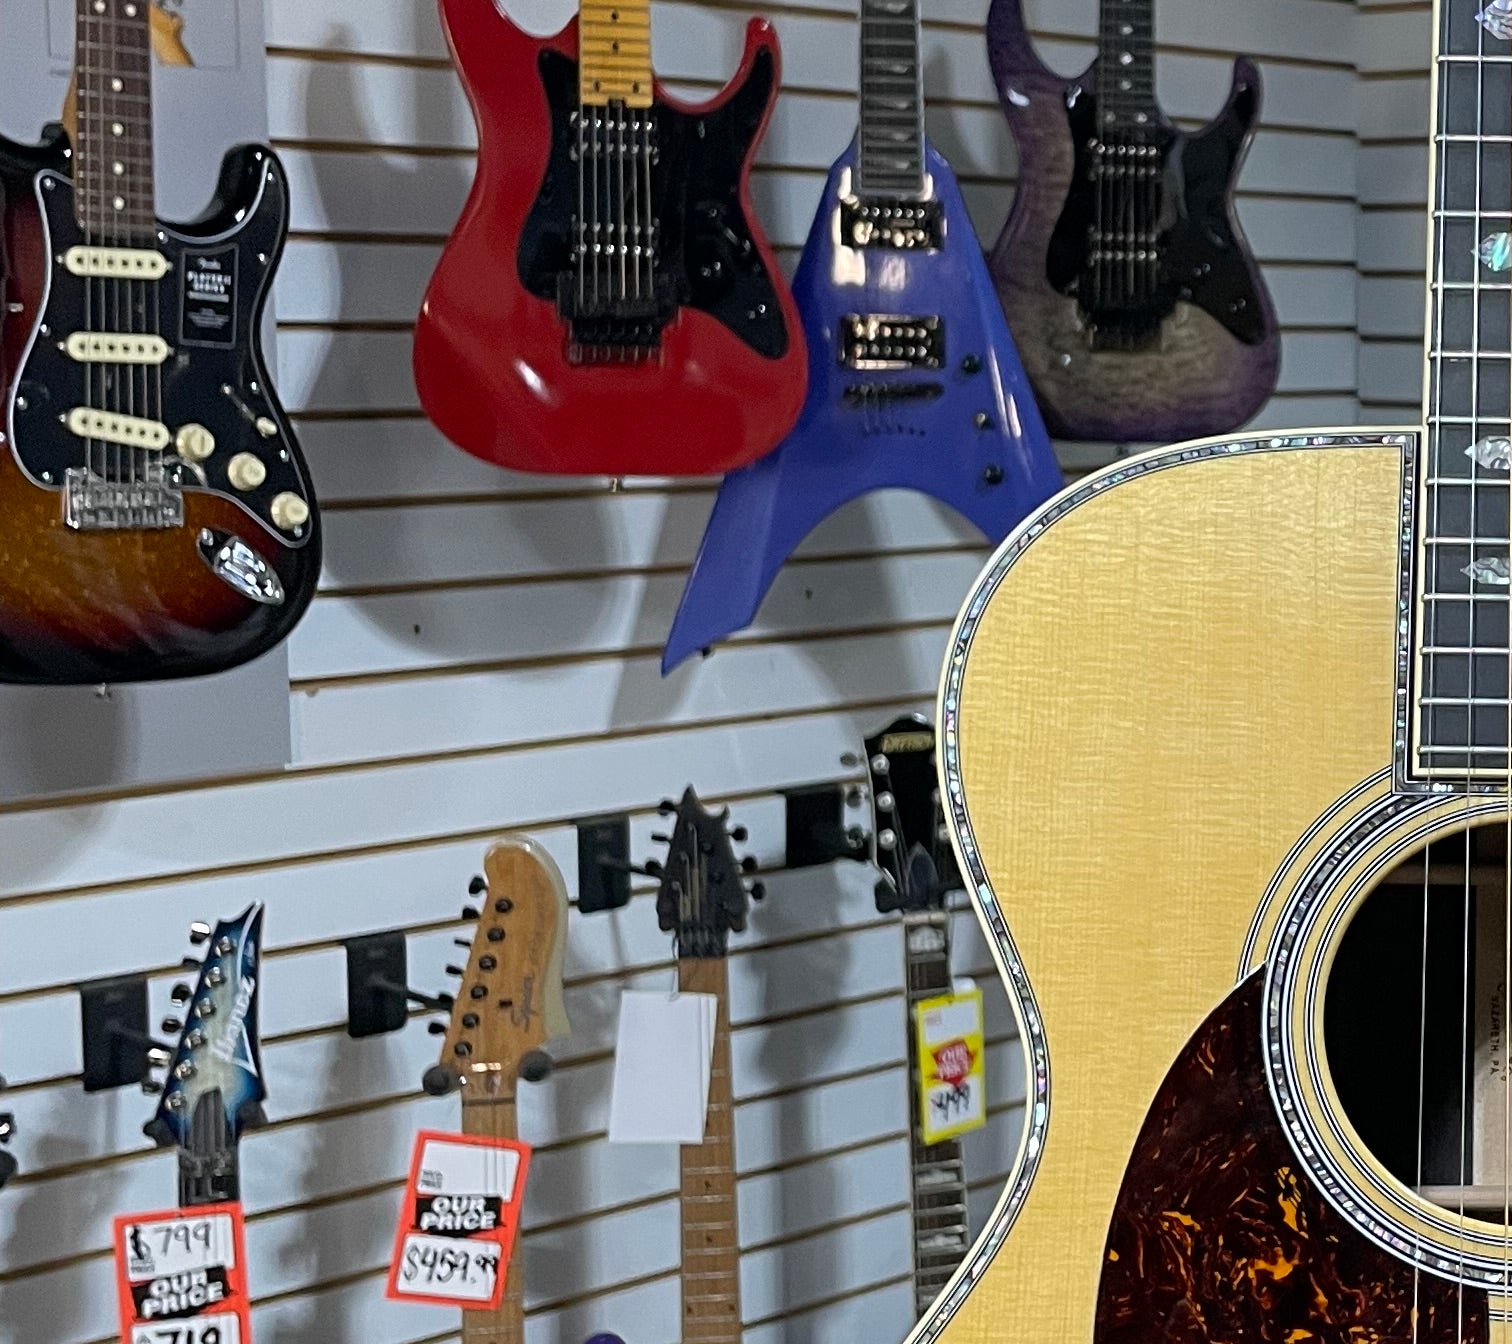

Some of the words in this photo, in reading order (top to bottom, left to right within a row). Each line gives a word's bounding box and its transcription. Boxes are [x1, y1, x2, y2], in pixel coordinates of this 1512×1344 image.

[431, 1195, 487, 1215] OUR
[420, 1210, 497, 1231] PRICE
[149, 1270, 208, 1299] OUR
[141, 1280, 224, 1319] PRICE
